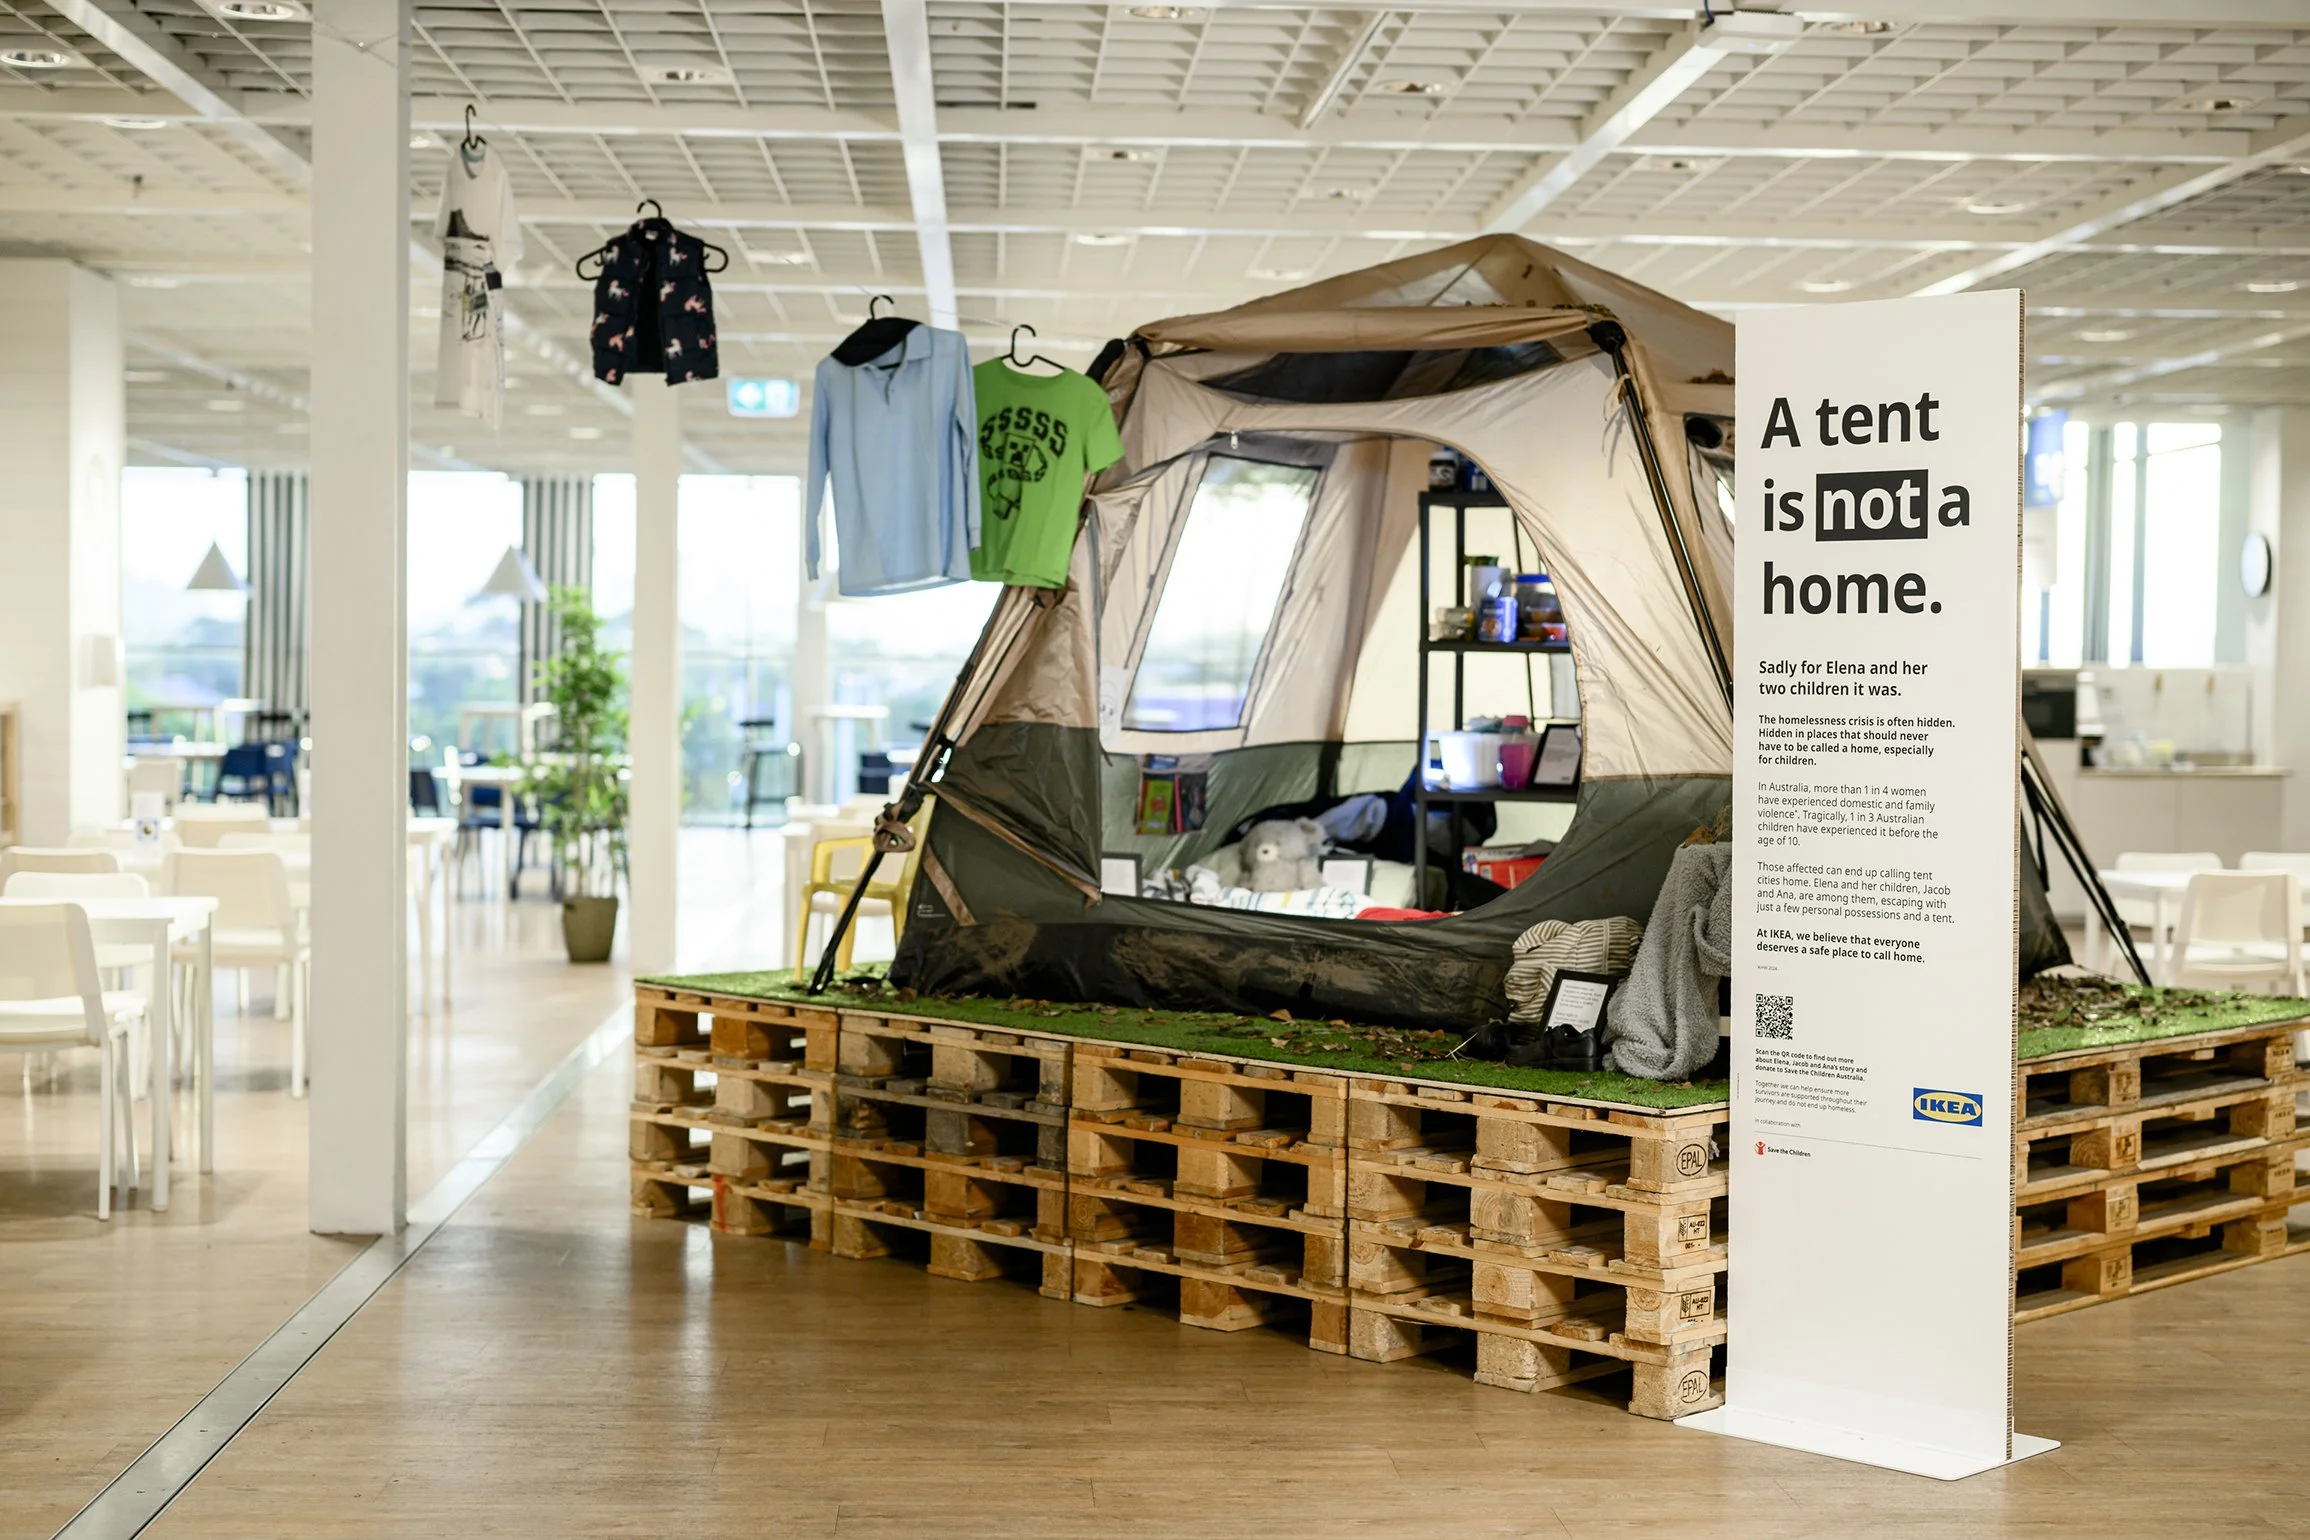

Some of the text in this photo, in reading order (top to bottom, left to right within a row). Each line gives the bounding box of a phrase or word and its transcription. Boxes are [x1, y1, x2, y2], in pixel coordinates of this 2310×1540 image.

[1760, 392, 1940, 448] A tent
[1763, 478, 1970, 532] is not a
[1763, 561, 1942, 614] home.
[1759, 660, 1928, 678] Sadly for Elena and her
[1759, 681, 1901, 696] two children it was.
[1759, 714, 1955, 728] The homelessness crisis is often hidden.
[1759, 728, 1928, 741] Hidden in places that should never
[1759, 741, 1934, 758] have to be called a home, especially
[1758, 754, 1816, 766] for children.
[1758, 782, 1926, 796] In Australia, more than 1 in 4 women
[1758, 795, 1935, 813] have experienced domestic and family
[1803, 810, 1924, 824] Tragically, 1 in 3 Australian
[1758, 822, 1938, 839] children have experienced it before the
[1758, 836, 1800, 847] age of 10.
[1758, 862, 1932, 882] Those affected can end up calling tent
[1757, 876, 1951, 895] cities home. Elena and her children, Jacob
[1757, 889, 1946, 910] and Ana, are among them, escaping with
[1756, 903, 1954, 923] just a few personal possessions and a tent.
[1756, 928, 1920, 950] At IKEA, we believe that everyone
[1757, 942, 1925, 963] deserves a safe place to call home.
[1774, 1058, 1791, 1066] Elena,
[1839, 1066, 1855, 1074] story
[1810, 1070, 1835, 1078] Children
[1836, 1073, 1864, 1081] Australia.
[1755, 1080, 1779, 1088] Together
[1801, 1085, 1813, 1093] help
[1754, 1097, 1776, 1106] journey
[1828, 1104, 1856, 1113] homeless.
[1791, 1093, 1820, 1101] supported
[1820, 1095, 1853, 1105] throughout
[1920, 1097, 1977, 1117] IKEA
[1681, 1150, 1702, 1170] EPAL
[1789, 1149, 1811, 1157] Children
[1682, 1376, 1704, 1398] EPAL
